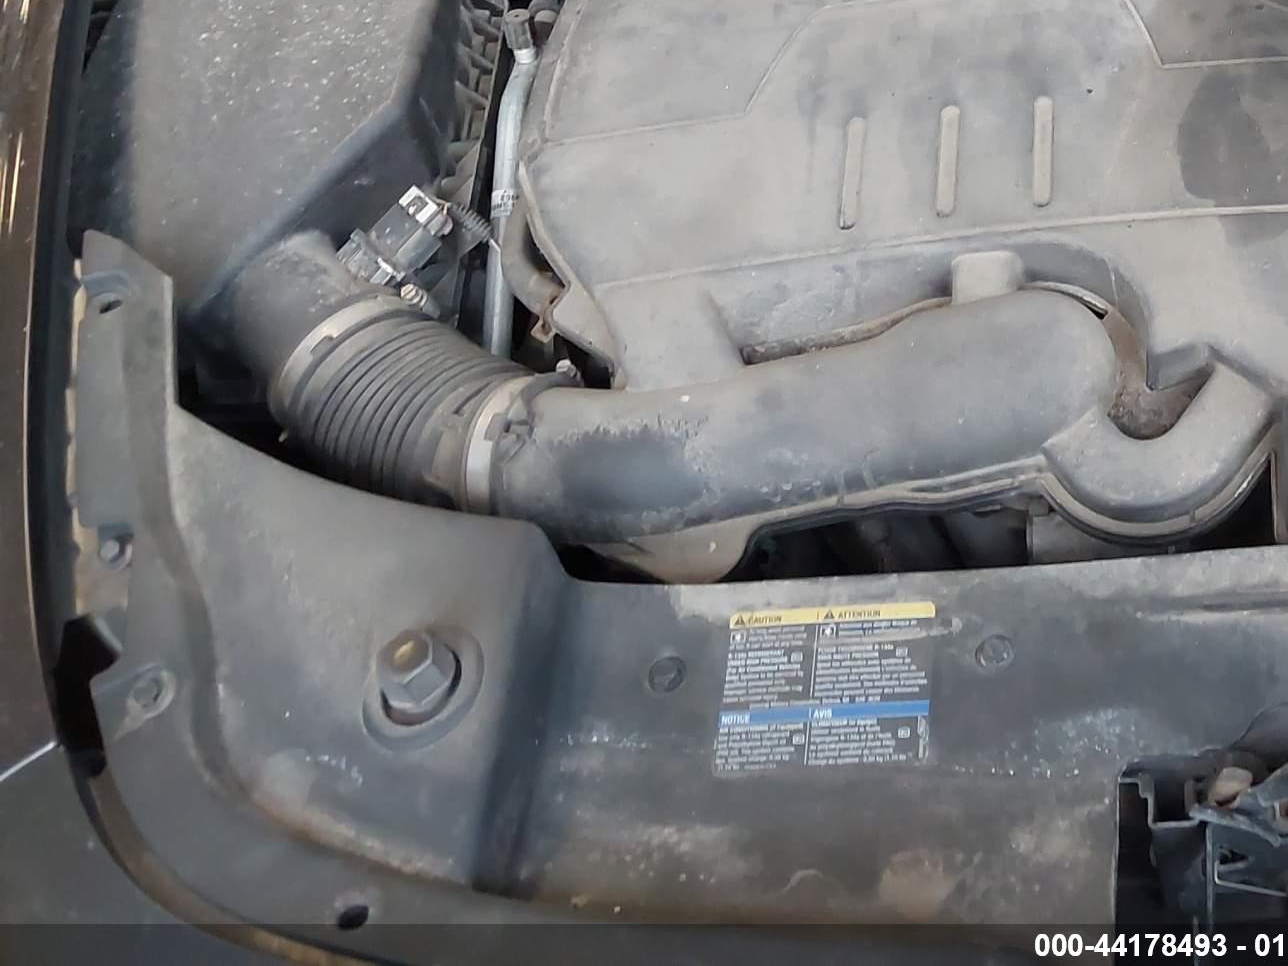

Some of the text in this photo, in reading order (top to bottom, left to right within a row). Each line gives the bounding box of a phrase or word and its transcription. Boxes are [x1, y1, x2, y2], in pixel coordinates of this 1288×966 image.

[748, 615, 782, 624] CAUTION
[838, 609, 881, 619] ATTENTION
[721, 713, 750, 725] NOTICE
[813, 707, 832, 720] AVIS
